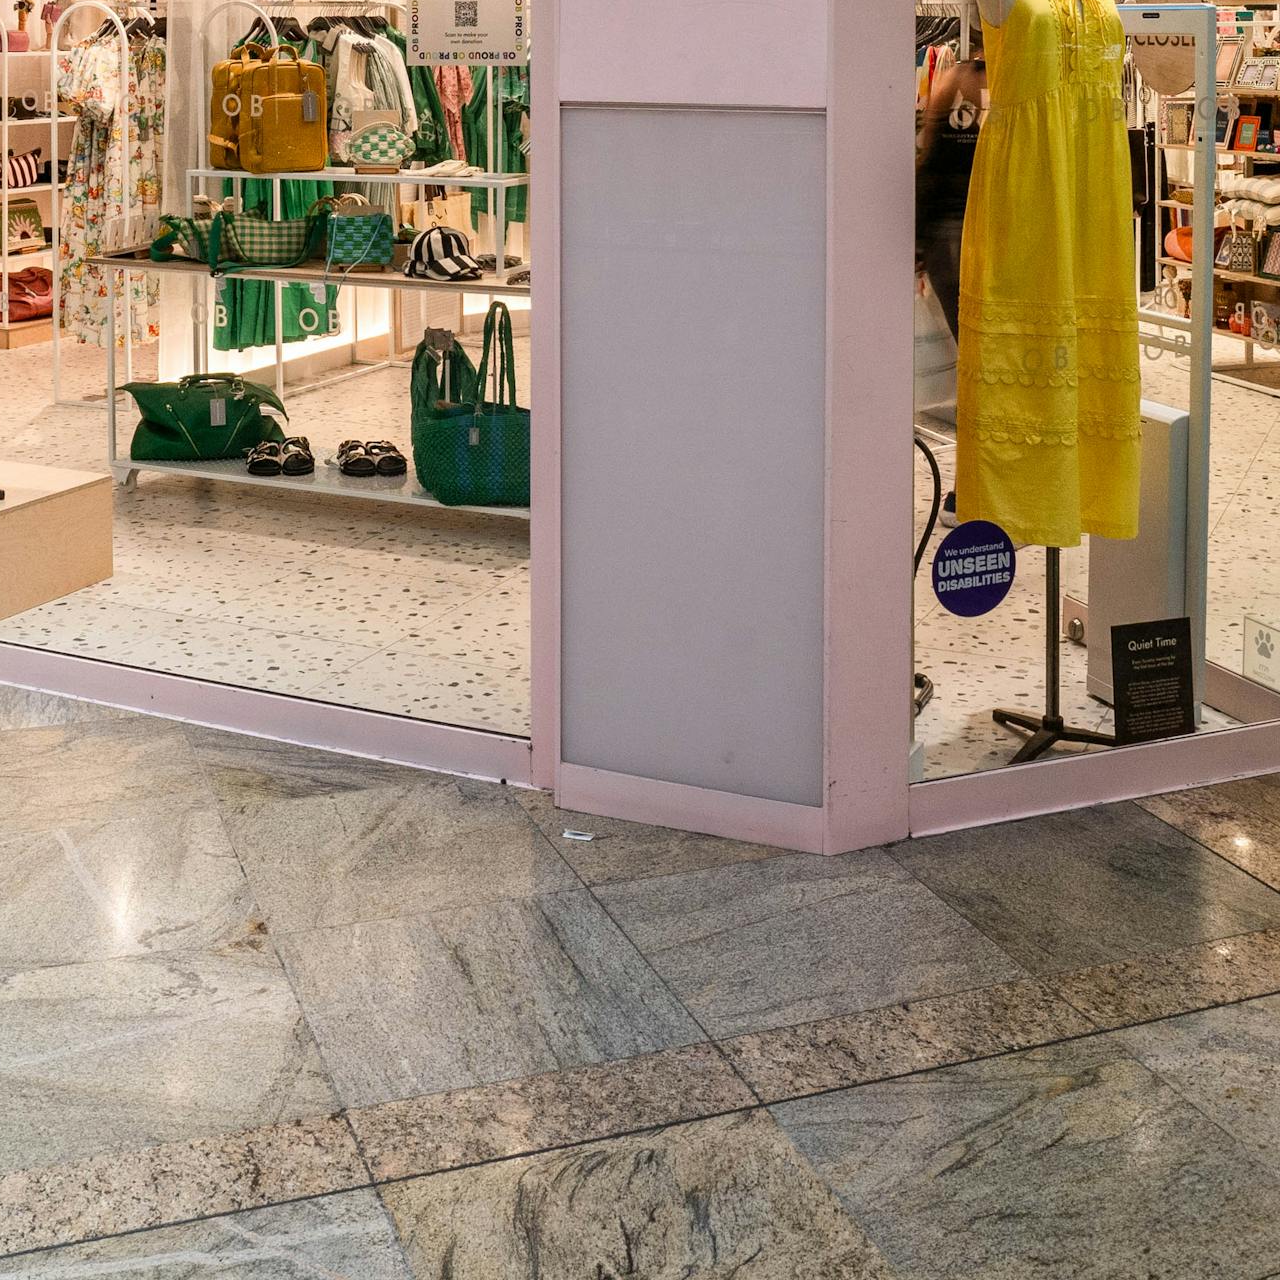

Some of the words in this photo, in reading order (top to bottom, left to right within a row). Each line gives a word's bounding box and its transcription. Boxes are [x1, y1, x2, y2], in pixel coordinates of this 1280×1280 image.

[1134, 35, 1196, 47] CLOSE
[222, 93, 264, 117] OB
[298, 308, 341, 333] OB
[944, 548, 958, 557] We
[959, 541, 1005, 555] understand
[937, 551, 1011, 578] UNSEEN
[937, 571, 1011, 593] DISABILITIES
[1127, 639, 1153, 651] Quiet
[1155, 637, 1177, 648] Time
